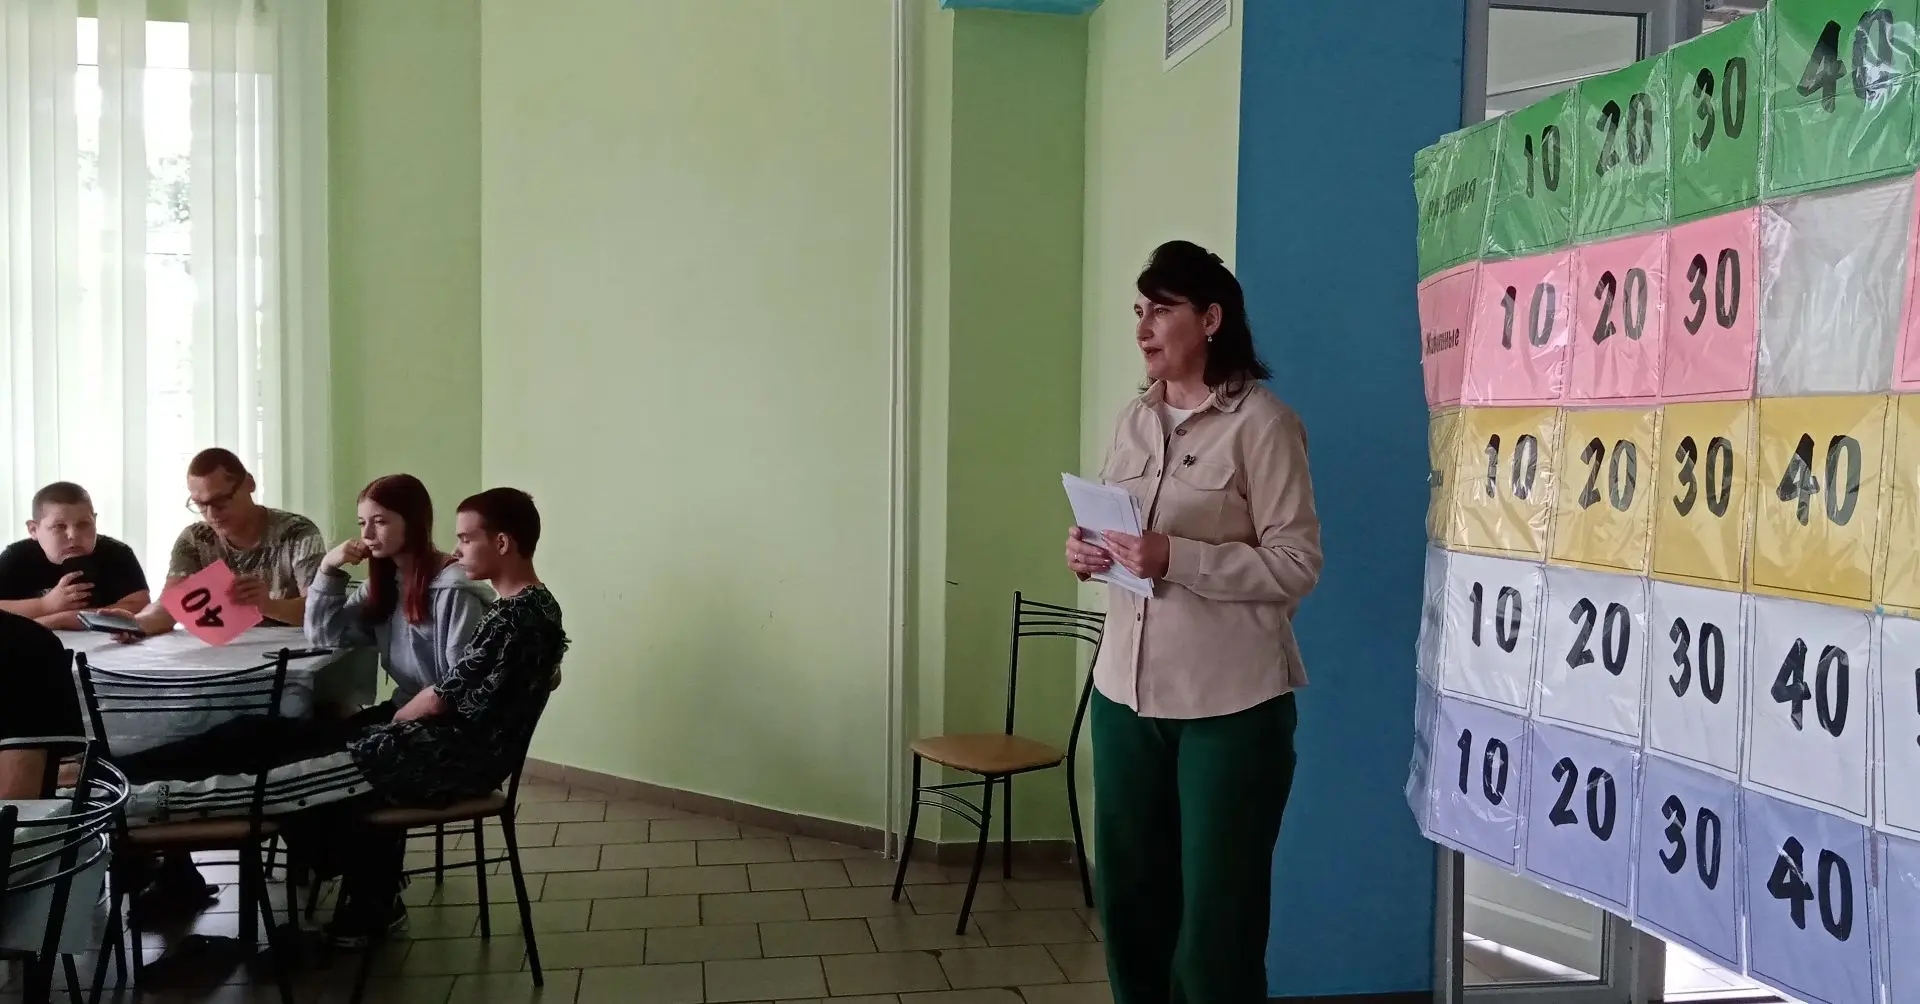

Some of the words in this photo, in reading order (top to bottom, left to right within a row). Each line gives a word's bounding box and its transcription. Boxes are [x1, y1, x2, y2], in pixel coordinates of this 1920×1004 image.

[1797, 9, 1893, 113] 40
[1595, 93, 1653, 177] 20
[1692, 57, 1747, 151] 30
[1523, 125, 1561, 198] 10
[1500, 283, 1556, 349] 10
[1592, 268, 1648, 345] 20
[1684, 248, 1741, 335] 30
[1484, 434, 1537, 499] 10
[1578, 437, 1637, 512] 20
[1673, 436, 1733, 518] 30
[1776, 433, 1862, 526] 40
[181, 587, 224, 627] 40
[1469, 582, 1521, 653] 10
[1566, 598, 1630, 675] 20
[1669, 617, 1725, 704] 30
[1771, 638, 1850, 737] 40
[1457, 729, 1508, 805] 10
[1549, 757, 1616, 841] 20
[1659, 795, 1721, 890] 30
[1767, 836, 1853, 941] 40
